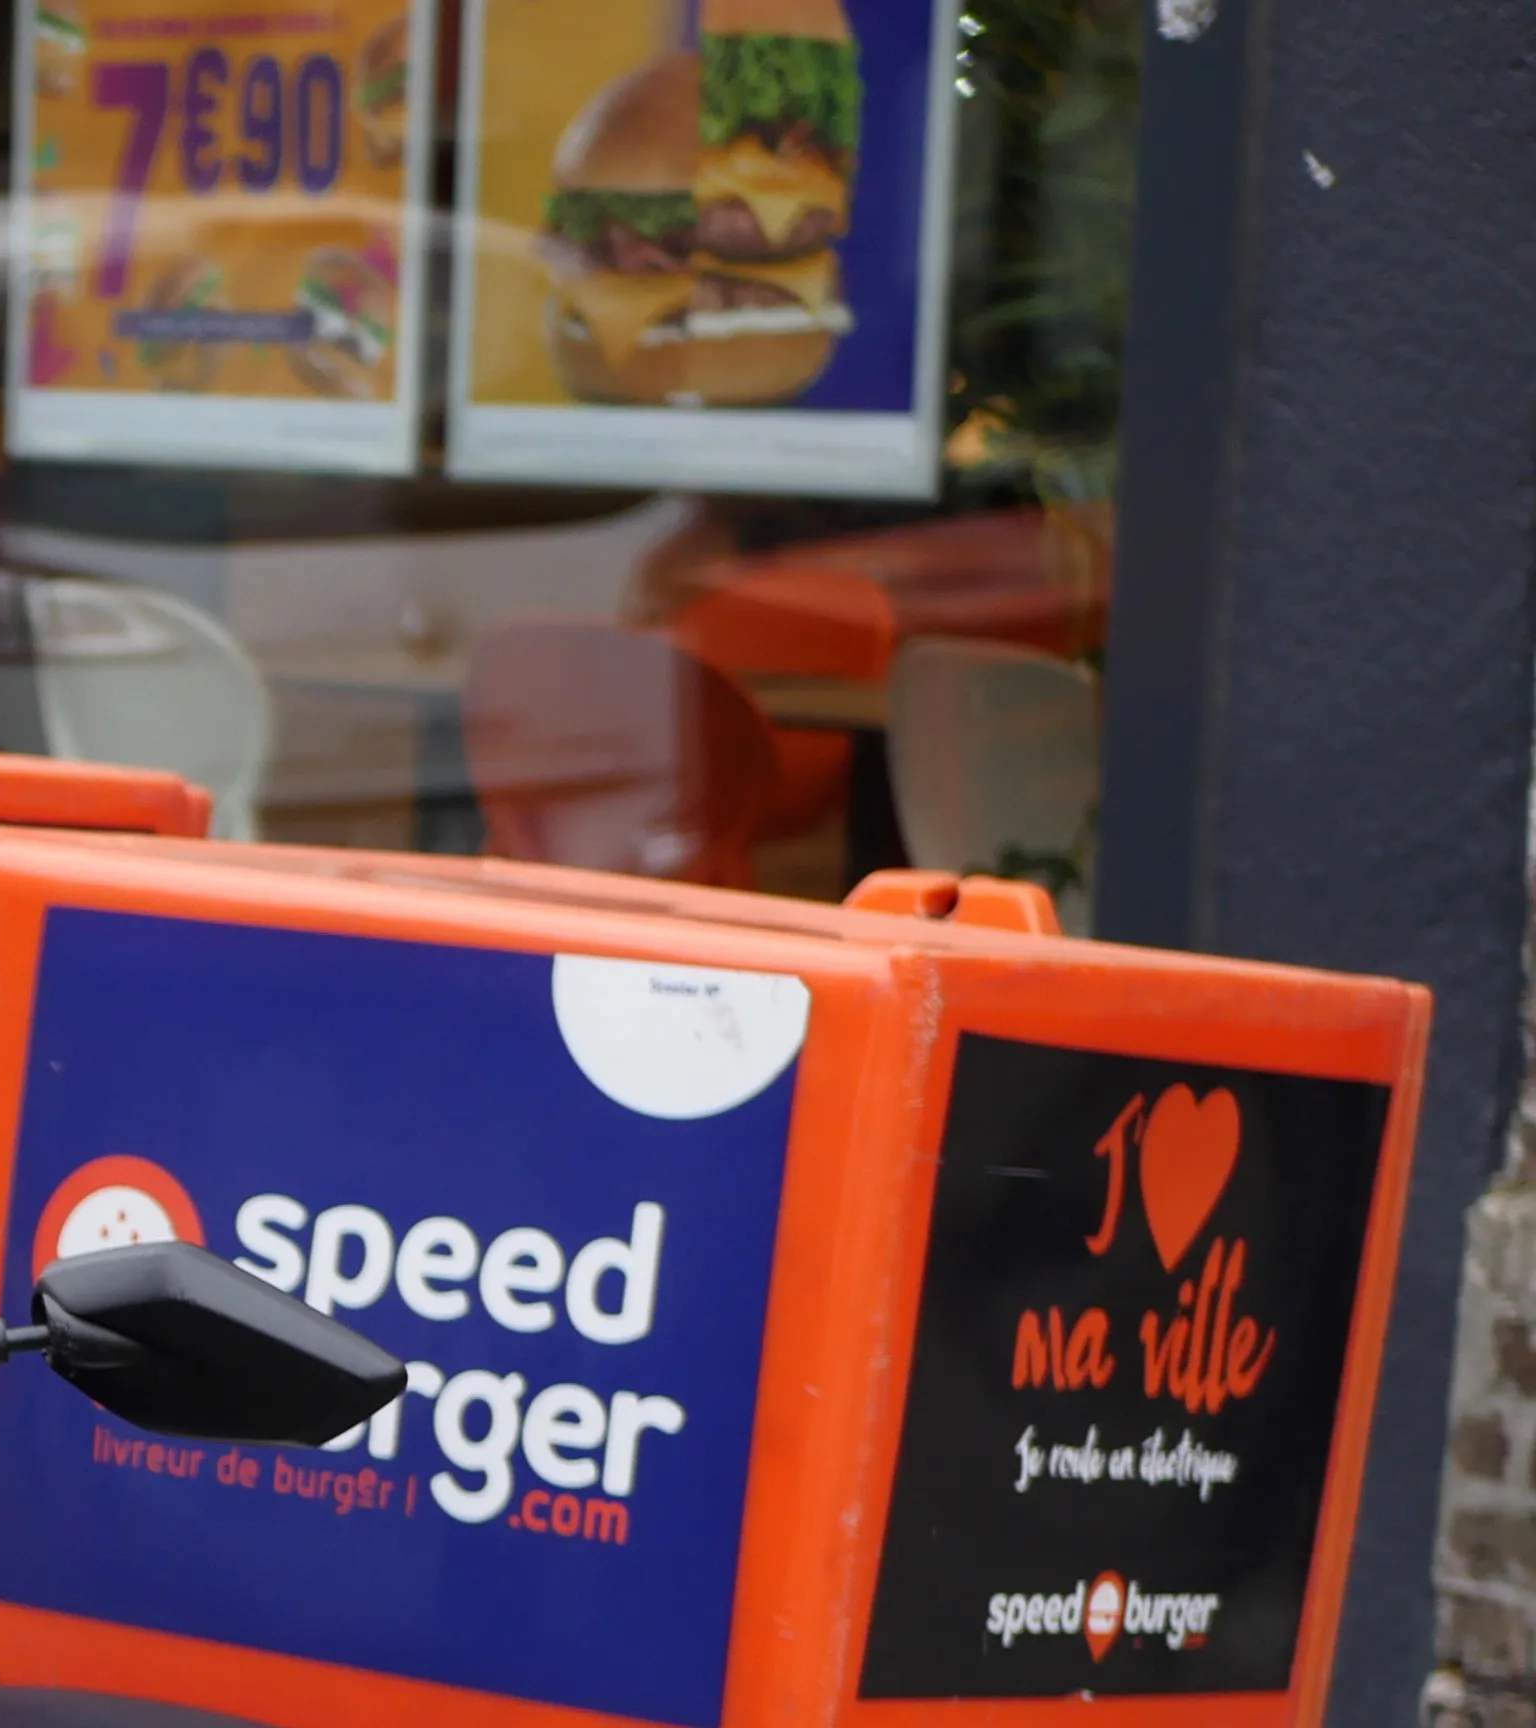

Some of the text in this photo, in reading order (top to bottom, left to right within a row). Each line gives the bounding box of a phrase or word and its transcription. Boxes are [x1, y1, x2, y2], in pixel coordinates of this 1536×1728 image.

[232, 1193, 666, 1345] speed
[1139, 1236, 1277, 1415] ville
[93, 1424, 205, 1479] livreur
[217, 1448, 260, 1489] de
[318, 1360, 686, 1524] rger
[507, 1490, 630, 1545] .com
[986, 1578, 1223, 1651] speed burger
